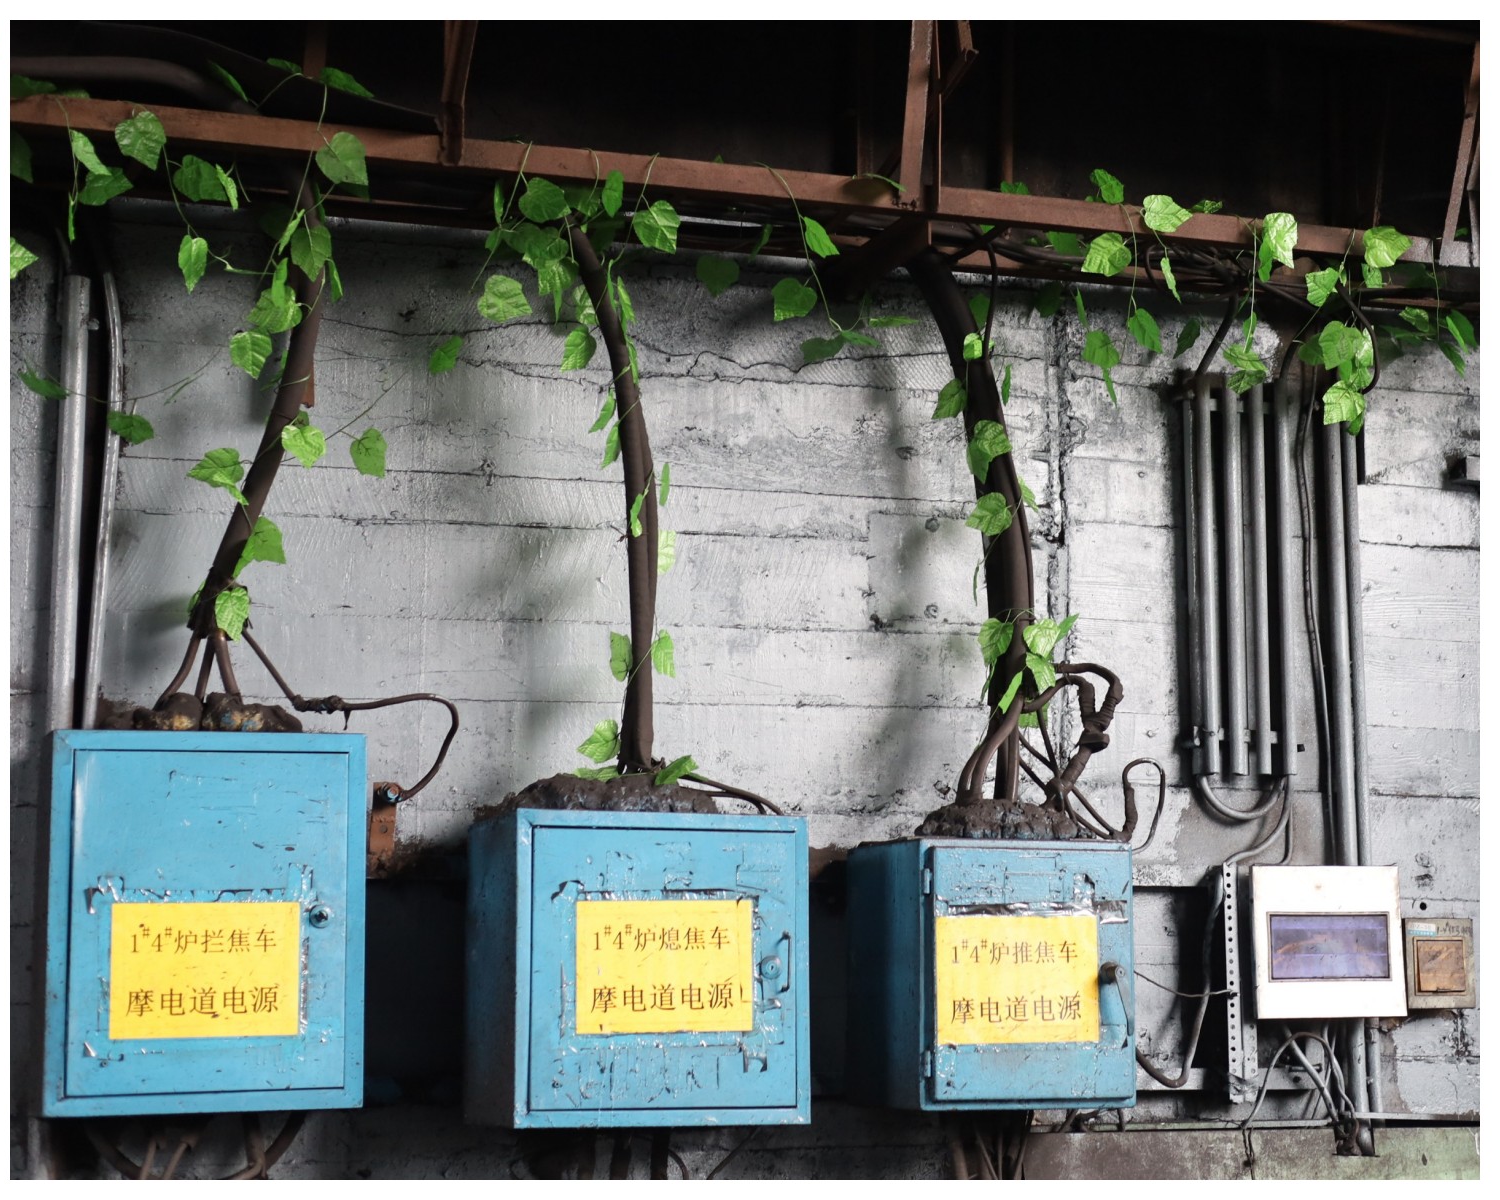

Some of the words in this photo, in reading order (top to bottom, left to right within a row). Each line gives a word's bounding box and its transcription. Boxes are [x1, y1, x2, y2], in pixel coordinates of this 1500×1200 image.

[125, 985, 279, 1017] 摩电道电源
[590, 982, 734, 1014] 摩电道电源
[950, 993, 1082, 1025] 摩电道电源
